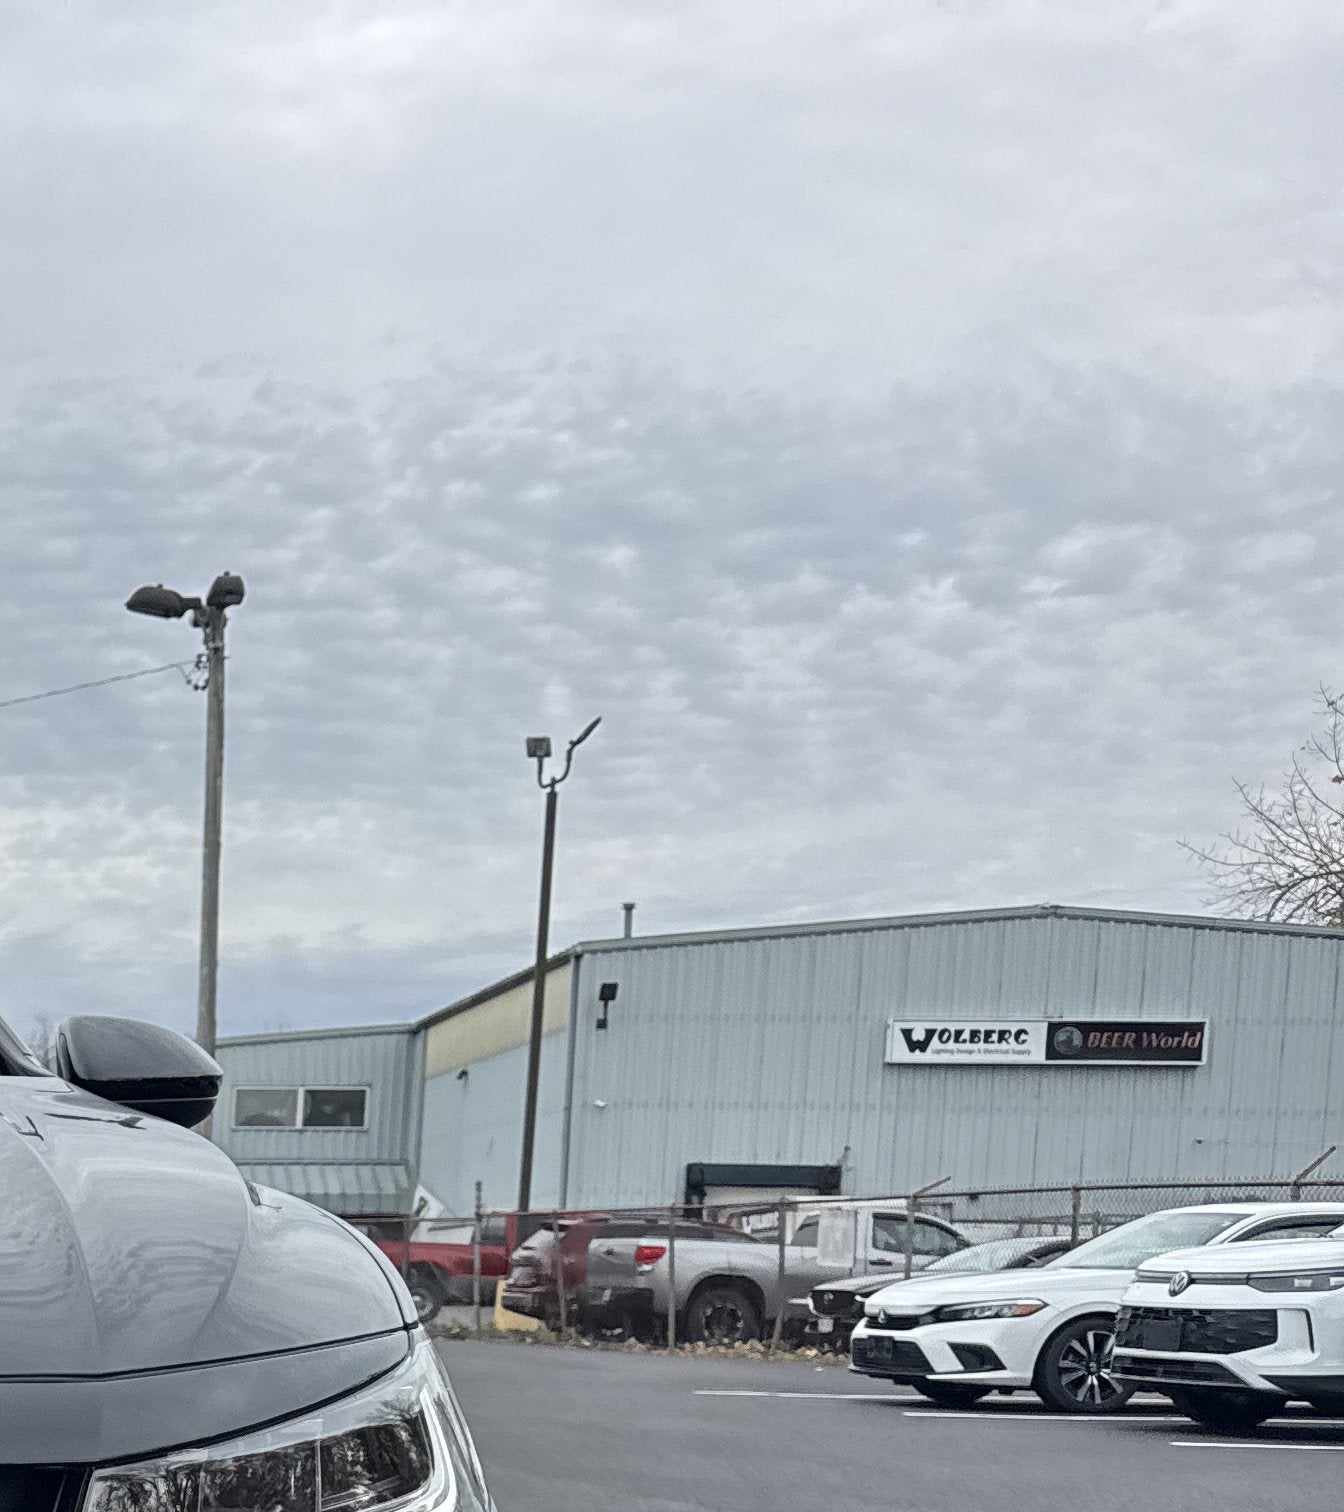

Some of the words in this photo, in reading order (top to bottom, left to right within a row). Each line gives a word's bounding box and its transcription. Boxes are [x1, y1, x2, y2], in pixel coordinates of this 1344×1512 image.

[900, 1028, 1029, 1053] WOLBERG
[1087, 1031, 1137, 1048] BEER
[1141, 1031, 1202, 1048] World
